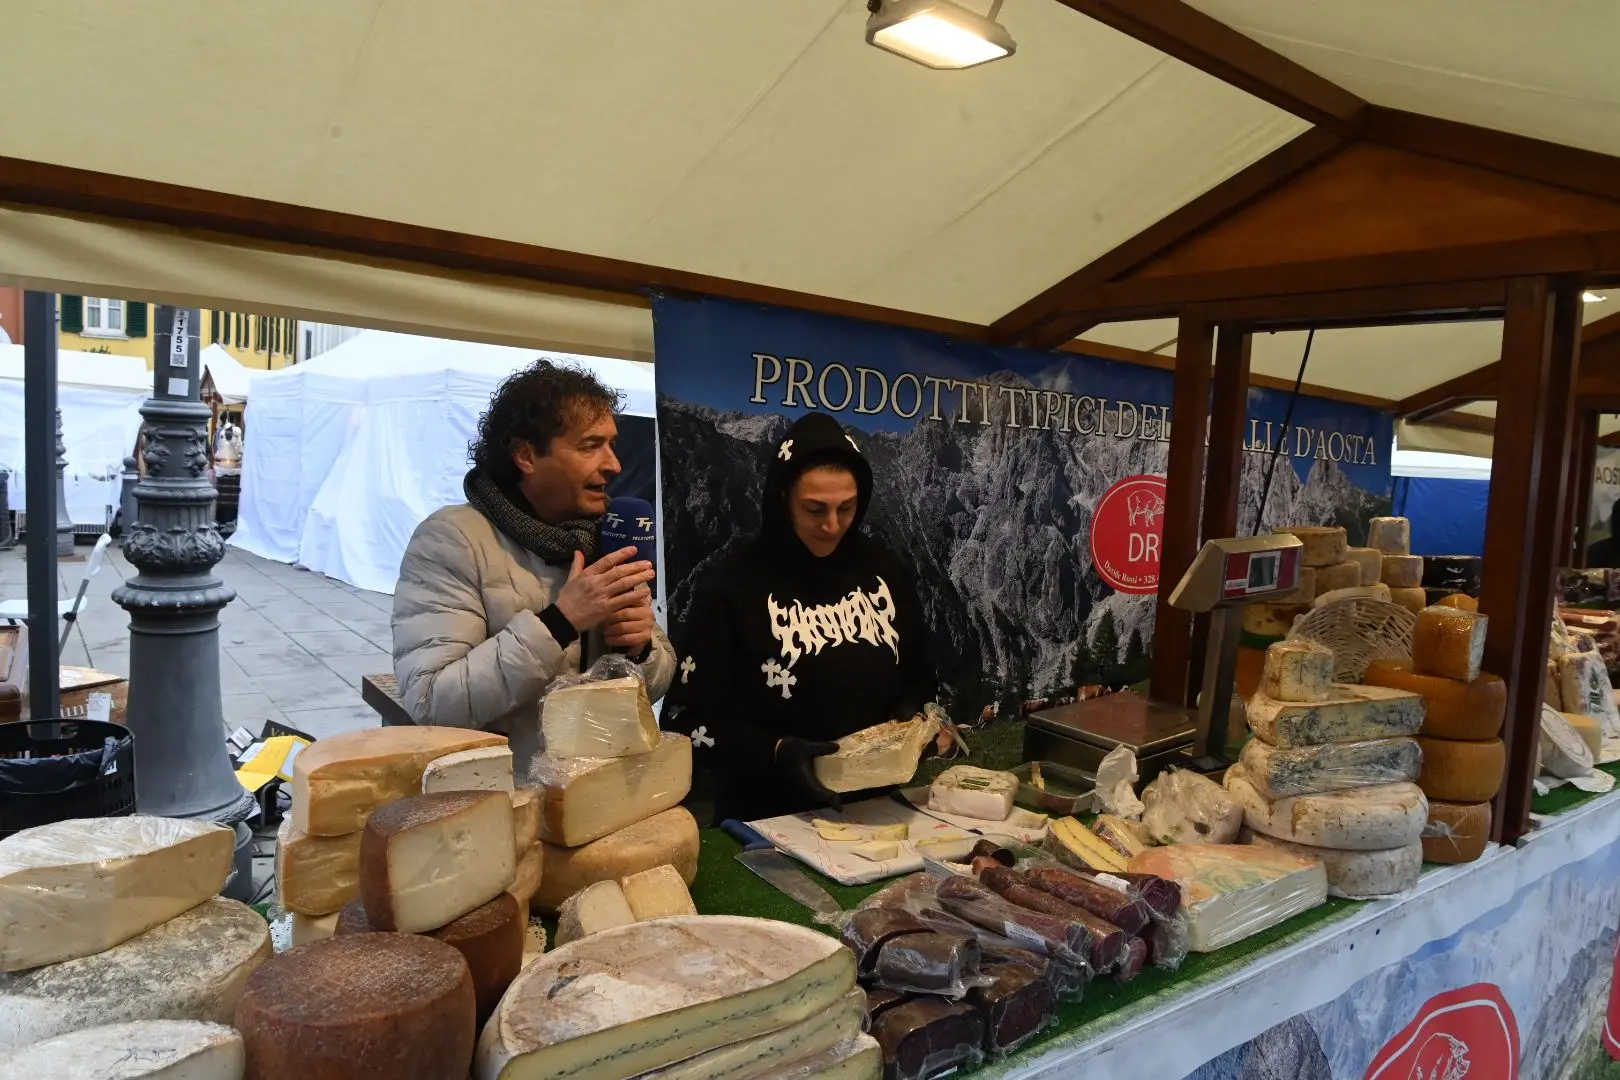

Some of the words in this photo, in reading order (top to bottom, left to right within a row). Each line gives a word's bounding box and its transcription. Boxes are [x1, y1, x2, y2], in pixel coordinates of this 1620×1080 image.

[175, 318, 184, 354] 1755
[749, 353, 992, 425] PRODOTTI
[998, 385, 1108, 437] TIPICI
[1295, 426, 1377, 465] D'AOSTA
[1128, 532, 1159, 563] DR
